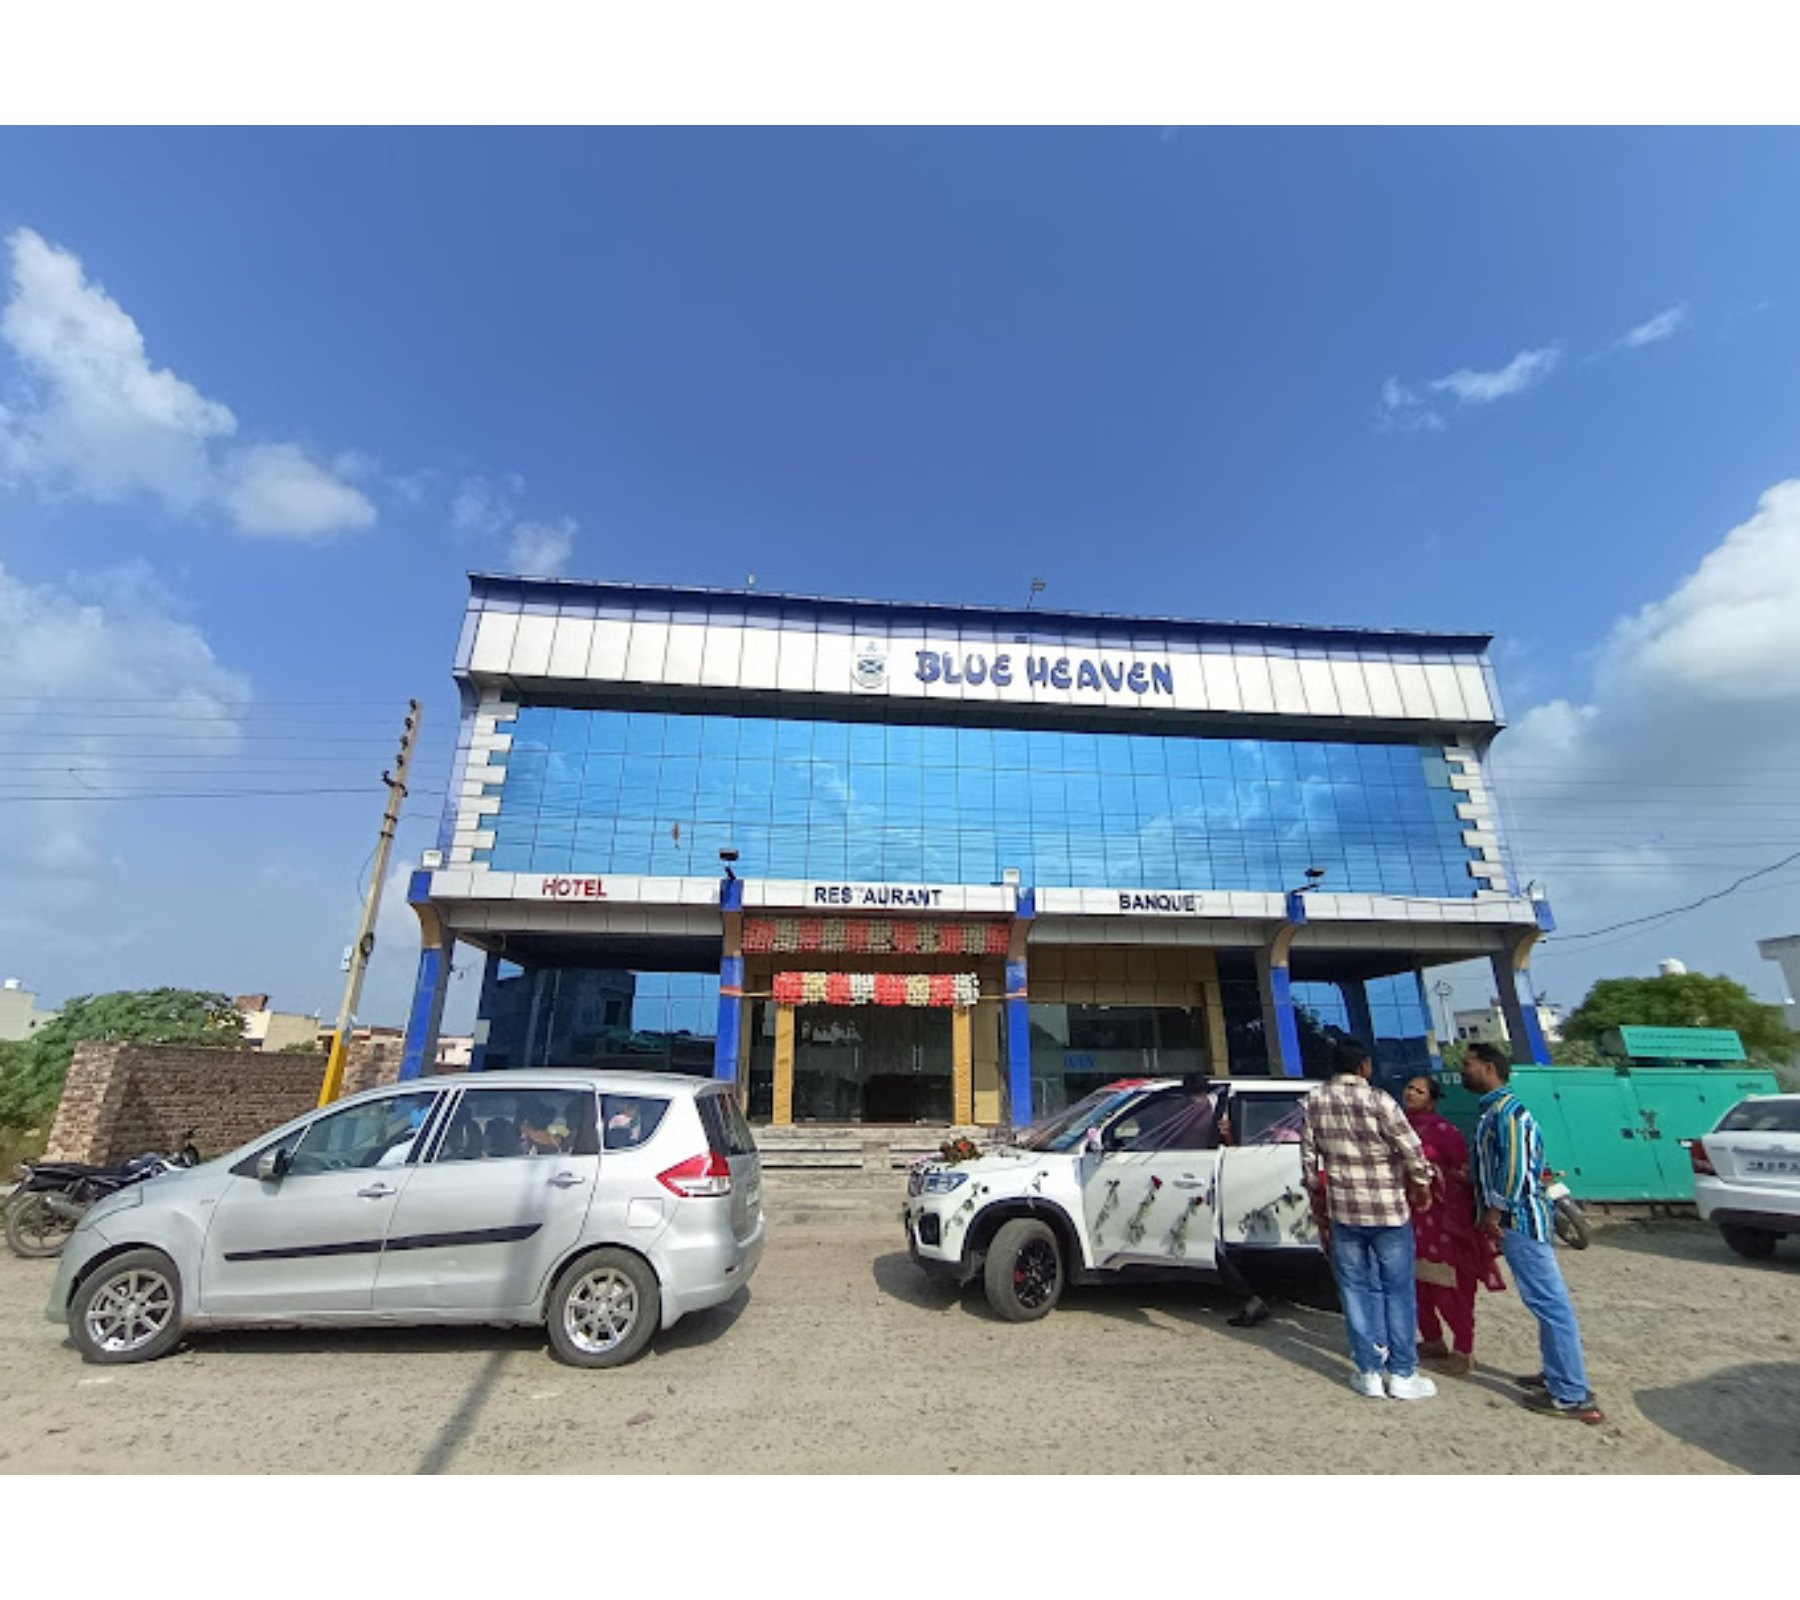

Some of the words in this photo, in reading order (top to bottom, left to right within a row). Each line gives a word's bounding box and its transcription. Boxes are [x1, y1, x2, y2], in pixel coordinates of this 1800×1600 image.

[915, 650, 1012, 687] BLUE
[1026, 656, 1174, 694] HEAVEN
[542, 878, 607, 896] HOTEL
